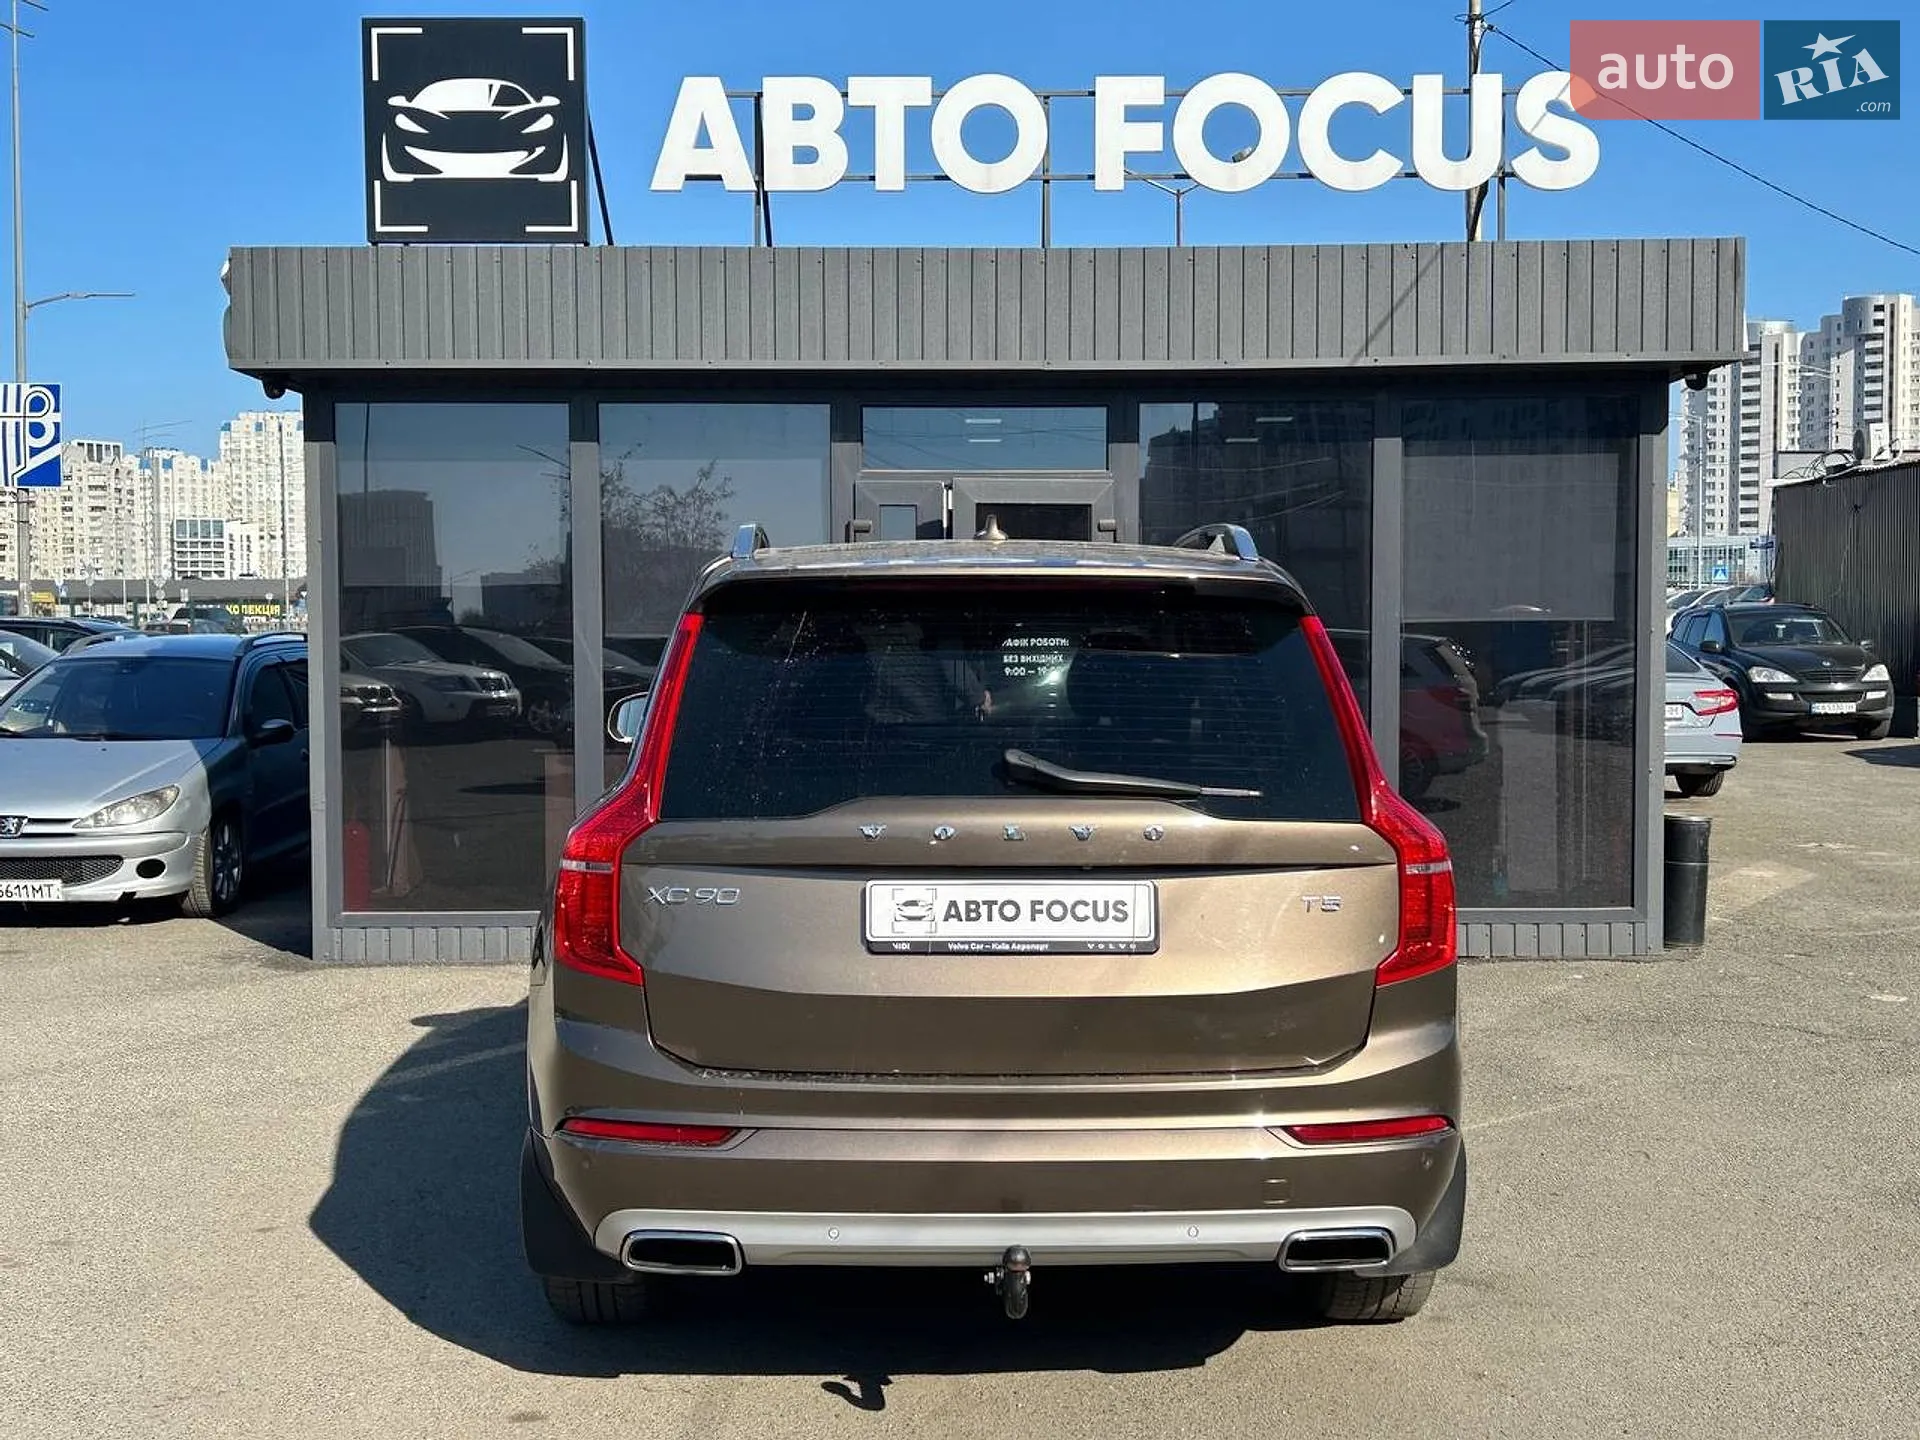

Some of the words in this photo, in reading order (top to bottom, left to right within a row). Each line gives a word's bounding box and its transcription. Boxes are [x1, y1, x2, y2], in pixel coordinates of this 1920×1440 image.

[649, 73, 1048, 194] АВТО
[1094, 71, 1601, 192] FOCUS
[860, 824, 1164, 841] VOLVO
[943, 899, 1021, 923] АВТО
[1030, 899, 1129, 923] FOCUS
[1302, 895, 1342, 912] T5
